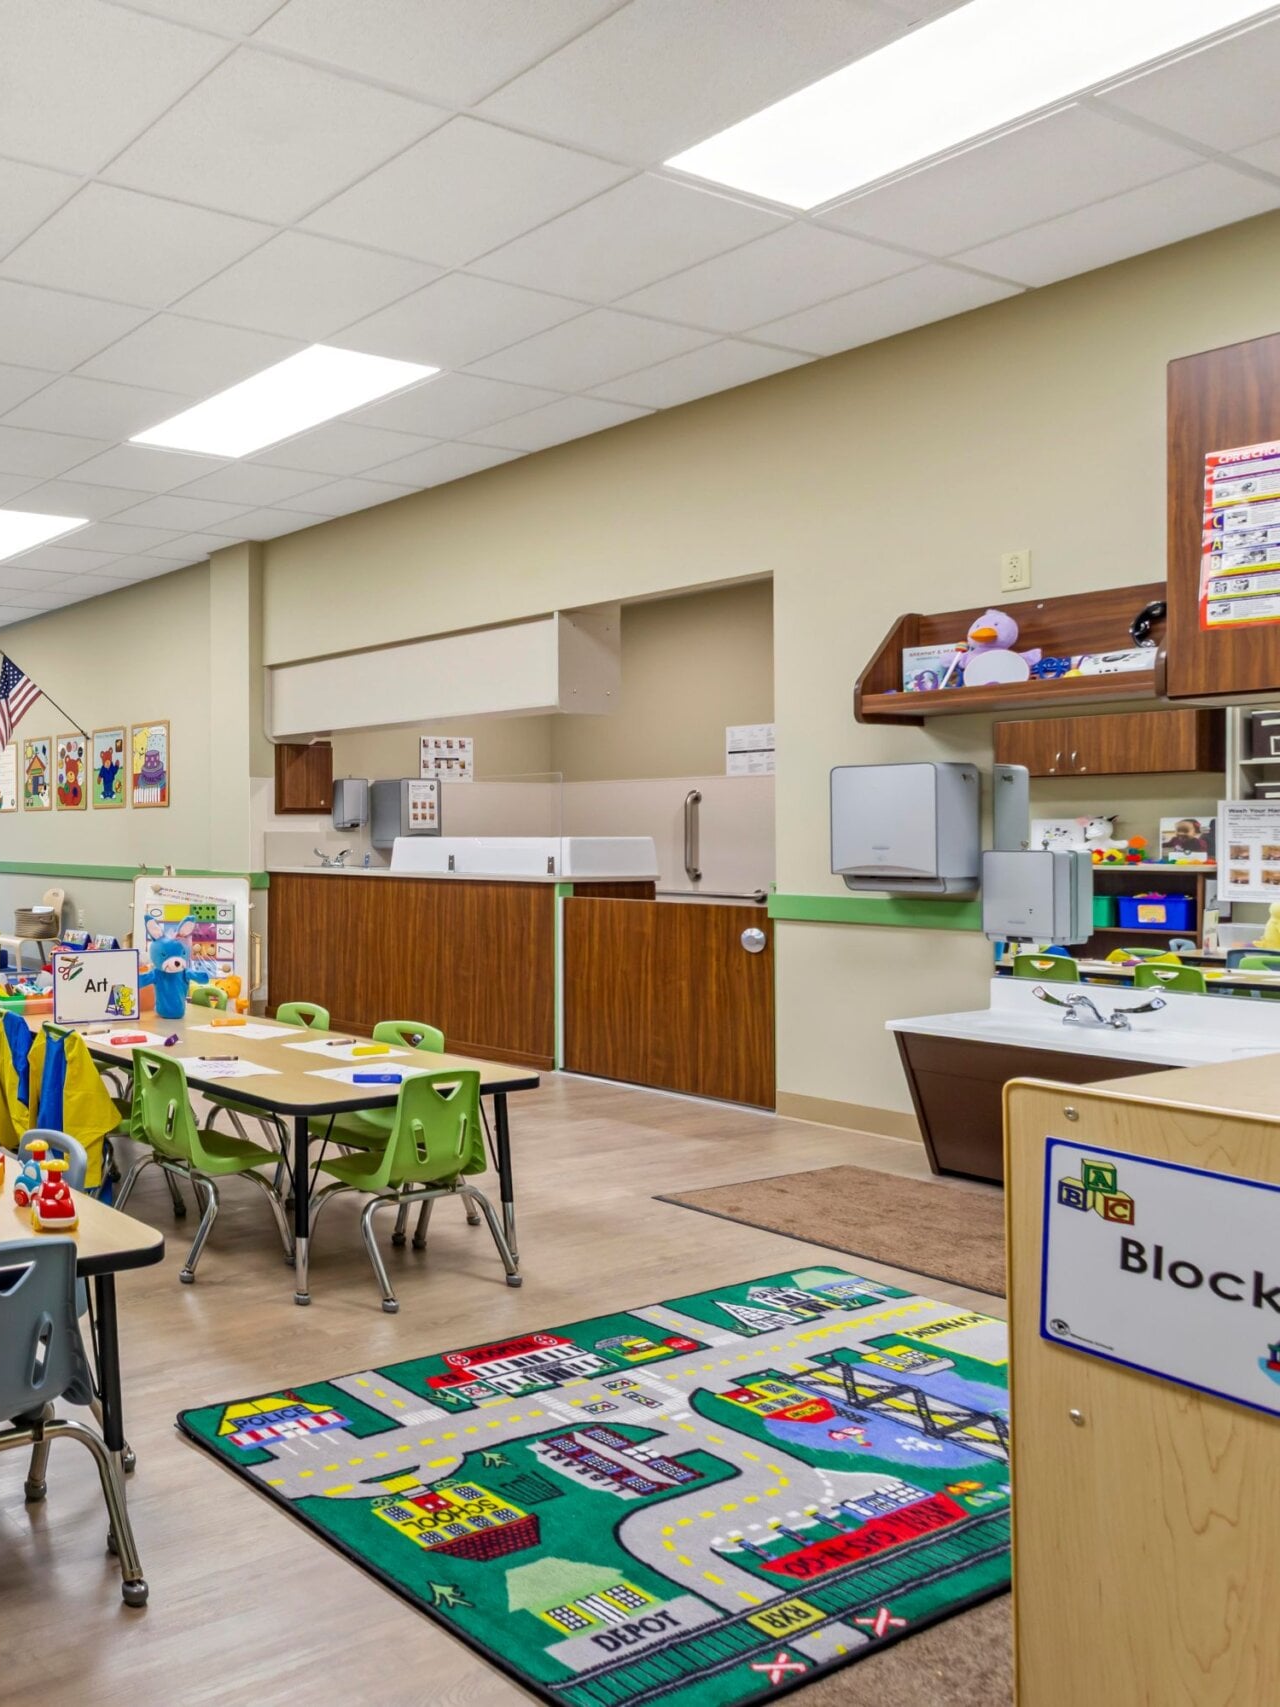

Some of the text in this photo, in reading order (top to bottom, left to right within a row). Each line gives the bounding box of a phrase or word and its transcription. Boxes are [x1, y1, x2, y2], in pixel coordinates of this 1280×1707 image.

[84, 977, 109, 993] Art
[1091, 1169, 1111, 1188] A
[1063, 1186, 1082, 1207] B
[1109, 1201, 1129, 1219] C
[1120, 1236, 1280, 1314] Block
[234, 1404, 309, 1432] POLICE
[538, 1448, 627, 1493] LIBRARY
[401, 1498, 500, 1532] SCHOOL
[758, 1603, 813, 1630] RXR
[590, 1609, 682, 1652] DEPOT
